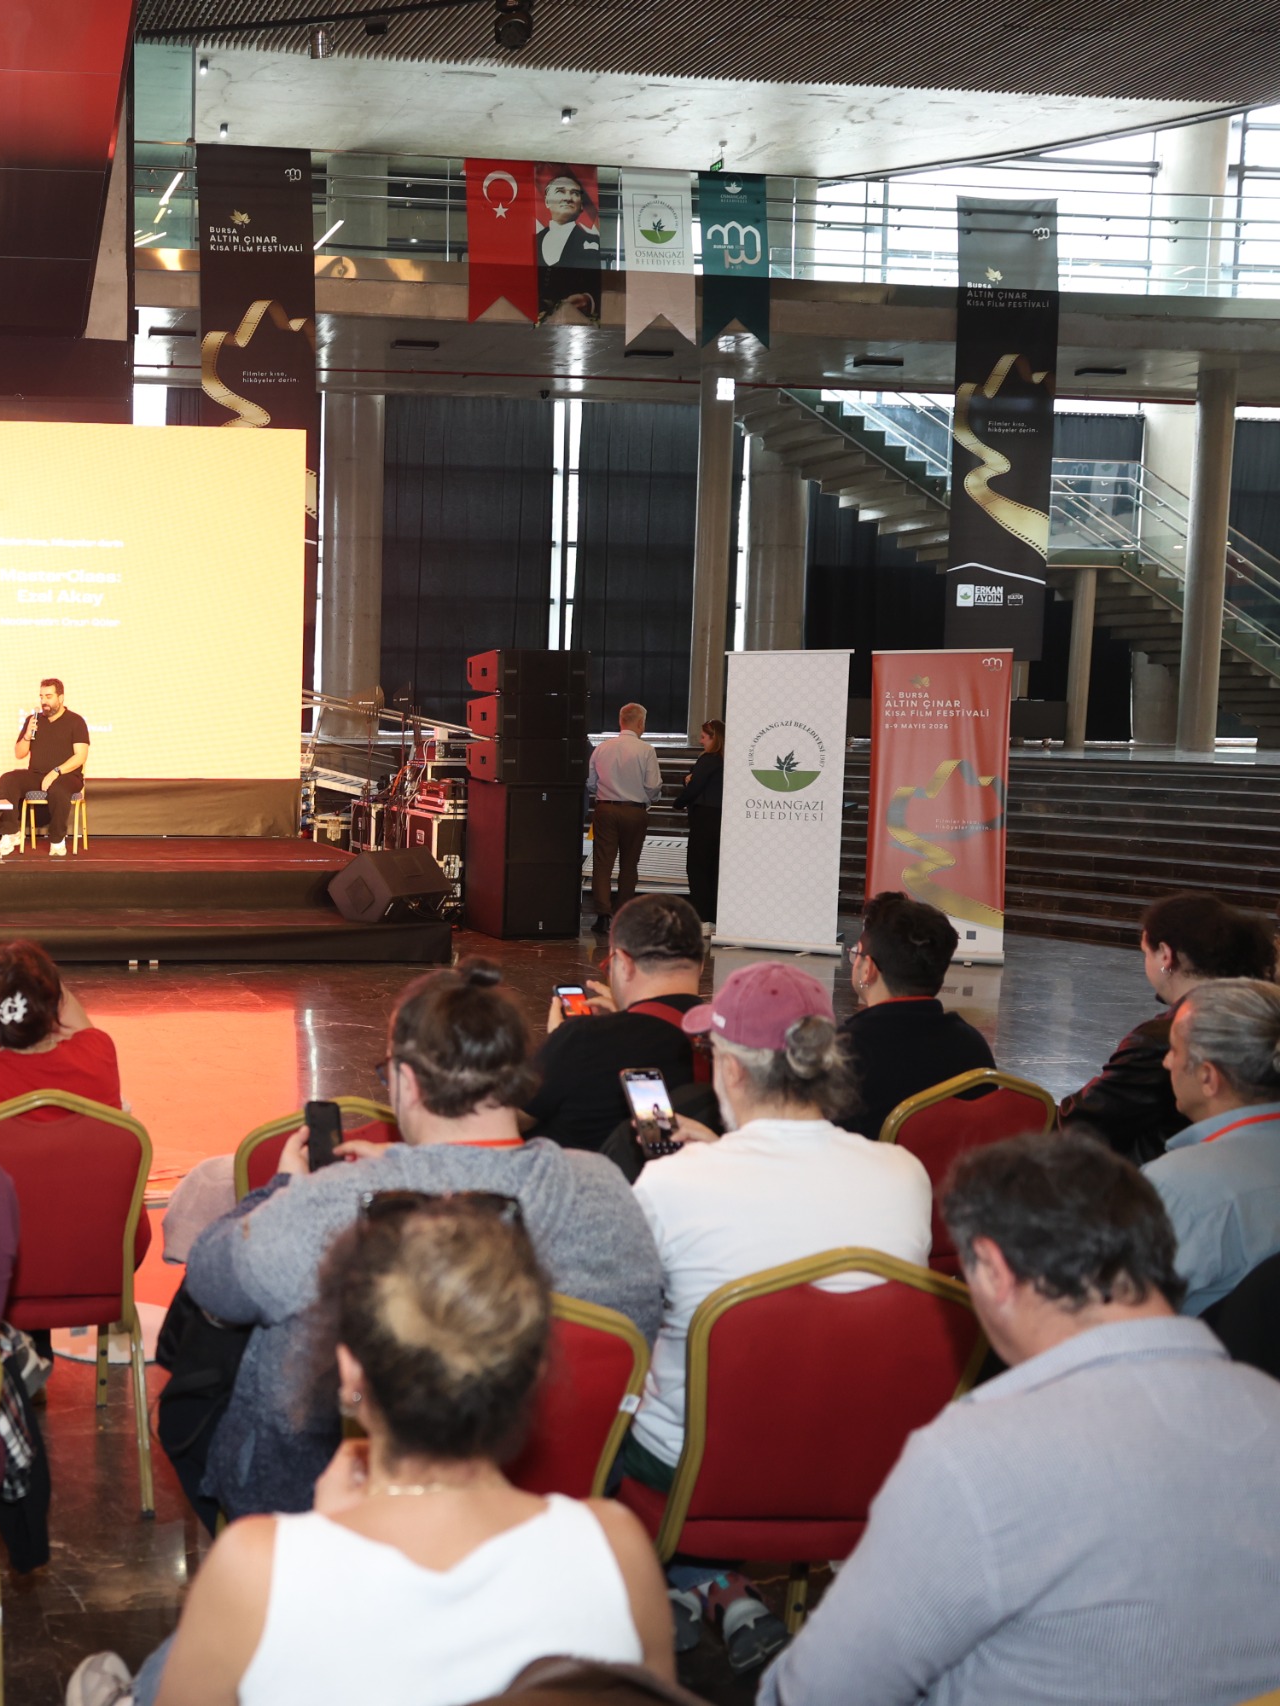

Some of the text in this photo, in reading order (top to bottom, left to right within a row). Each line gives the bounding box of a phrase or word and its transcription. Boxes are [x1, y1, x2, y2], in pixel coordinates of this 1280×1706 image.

[209, 226, 237, 234] BURSA
[209, 234, 278, 245] ALTIN ÇINAR
[233, 244, 254, 252] FİLM
[256, 243, 303, 252] FESTİVALİ
[967, 290, 1027, 300] ALTIN ÇINAR
[966, 299, 1049, 308] KISA FİLM FESTİVALİ
[975, 585, 1003, 594] ERKAN
[16, 589, 105, 607] Ezel Akay
[975, 594, 1003, 602] AYDIN
[885, 691, 930, 699] 2. BURSA
[885, 699, 961, 710] ALTIN ÇINAR
[910, 709, 933, 717] FİLM
[936, 708, 991, 718] FESTİVALİ
[753, 720, 793, 744] OSMANGAZİ
[745, 798, 824, 811] OSMANGAZİ
[745, 810, 824, 822] BELEDİYESİ
